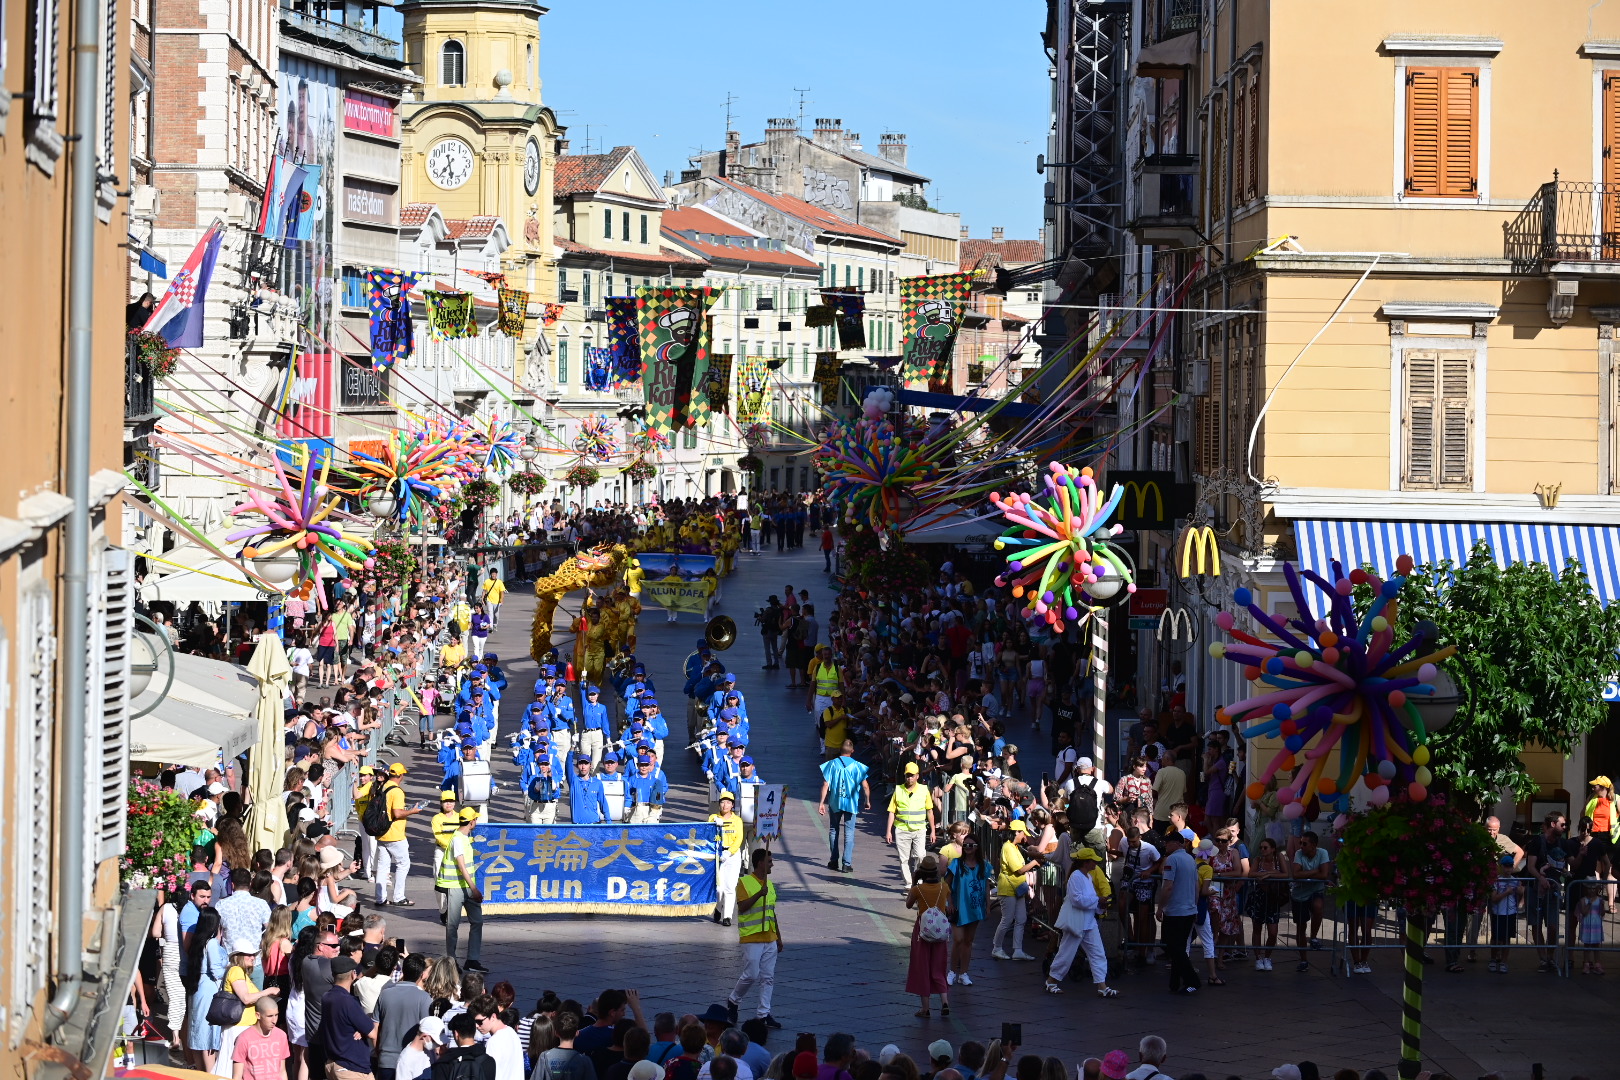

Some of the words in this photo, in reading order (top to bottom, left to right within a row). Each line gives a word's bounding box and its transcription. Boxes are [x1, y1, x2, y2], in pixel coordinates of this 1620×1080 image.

[344, 101, 392, 128] www.tommy.hr
[440, 144, 446, 153] 11
[448, 142, 456, 151] 12
[458, 144, 462, 154] 1
[432, 149, 441, 158] 10
[462, 150, 468, 158] 2
[429, 159, 436, 168] 9
[465, 159, 471, 168] 3
[432, 168, 439, 178] 8
[462, 168, 467, 177] 4
[440, 175, 446, 184] 7
[447, 178, 452, 186] 6
[454, 175, 461, 185] 5
[348, 190, 361, 212] naš
[368, 191, 384, 216] dom
[679, 588, 705, 599] DAFA
[766, 790, 775, 805] 4
[473, 828, 716, 875] 法輪大法
[483, 875, 583, 901] Falun
[606, 876, 692, 902] Dafa
